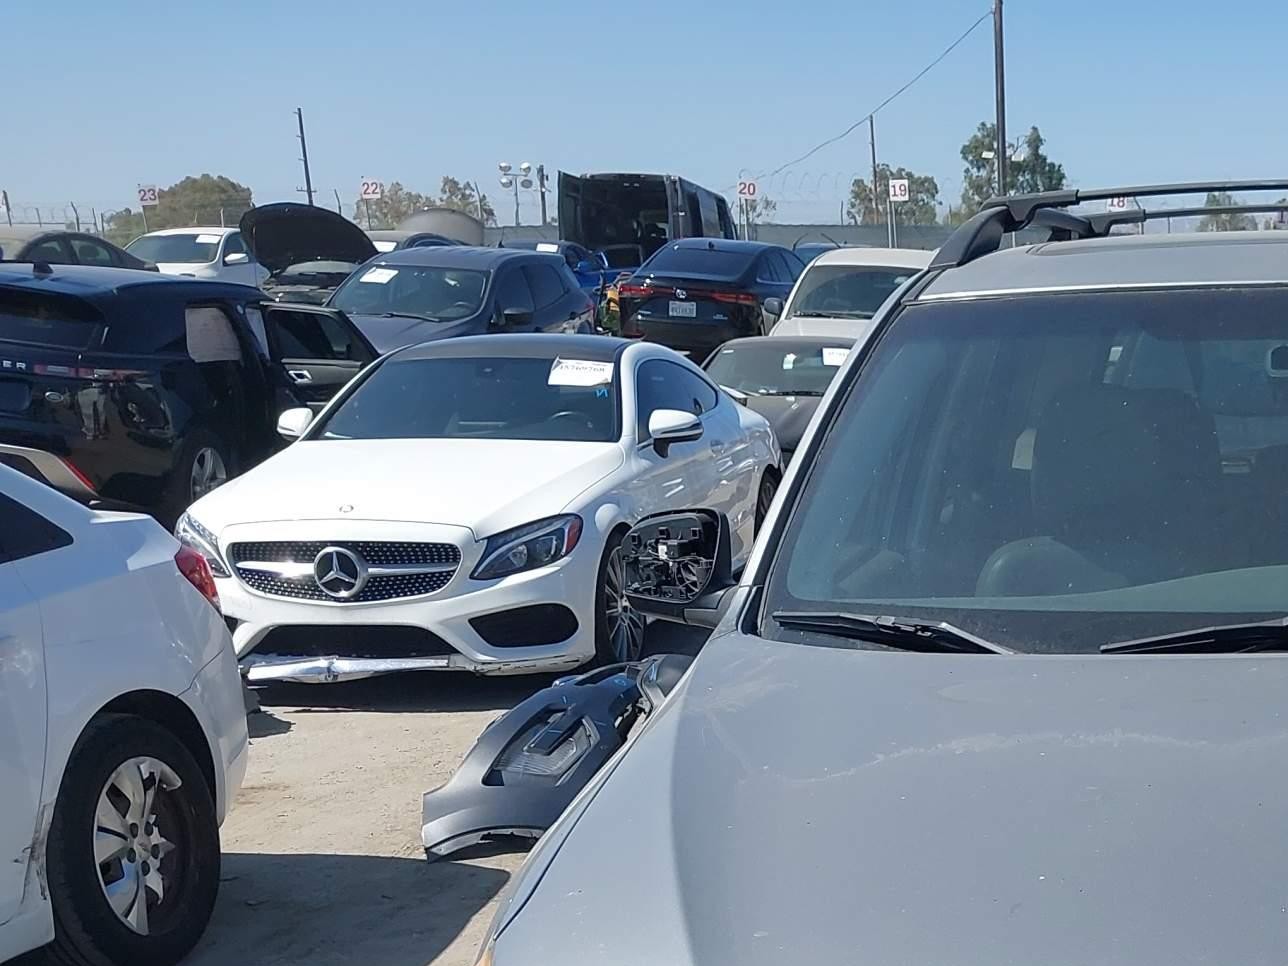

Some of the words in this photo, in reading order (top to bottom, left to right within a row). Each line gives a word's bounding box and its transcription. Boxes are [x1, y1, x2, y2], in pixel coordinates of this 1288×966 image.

[138, 188, 157, 202] 23
[362, 181, 379, 195] 22
[738, 181, 756, 195] 20
[891, 183, 907, 197] 19
[1108, 196, 1125, 208] 18
[0, 360, 26, 371] ER
